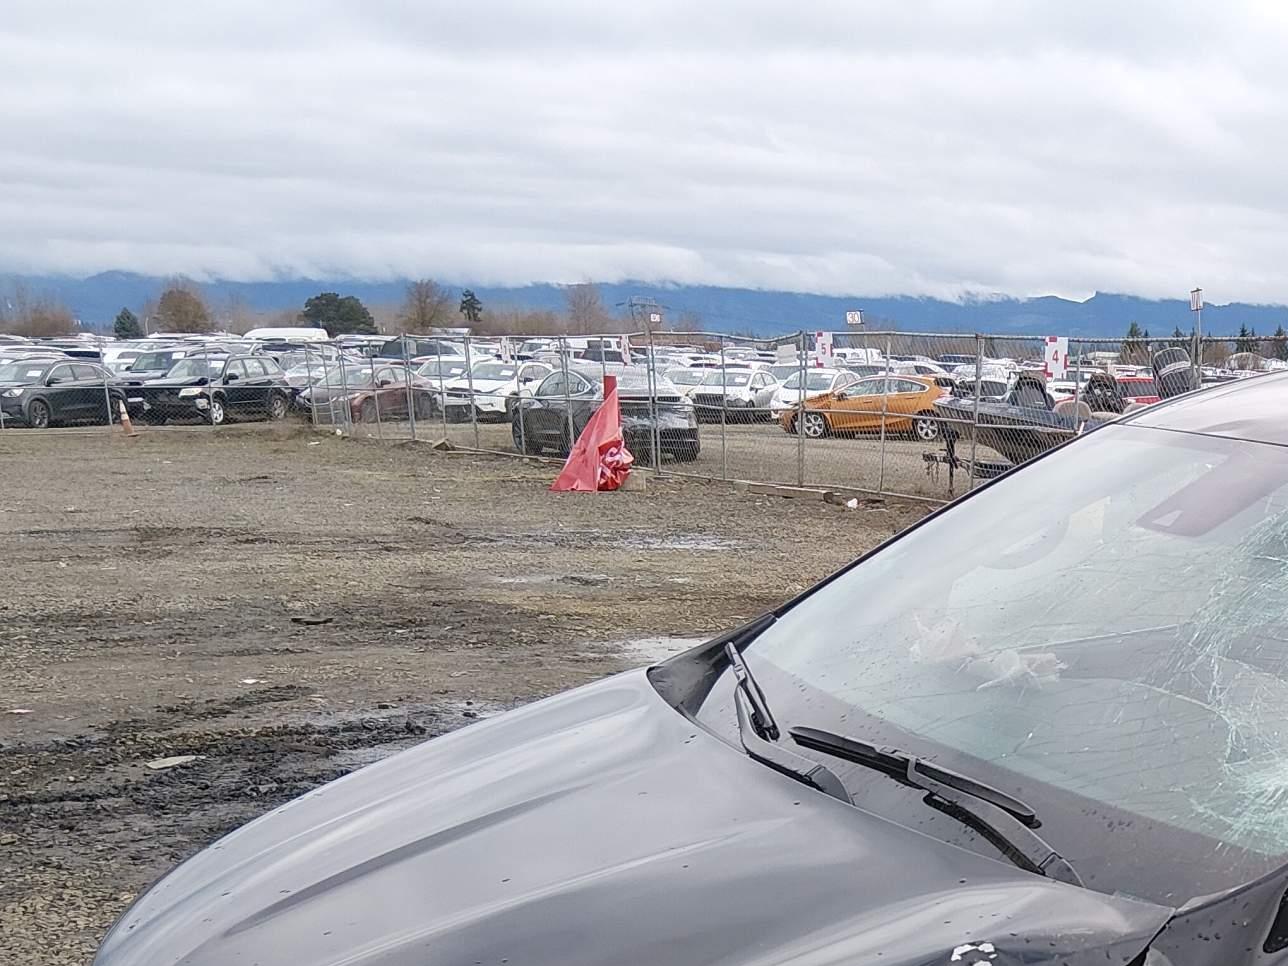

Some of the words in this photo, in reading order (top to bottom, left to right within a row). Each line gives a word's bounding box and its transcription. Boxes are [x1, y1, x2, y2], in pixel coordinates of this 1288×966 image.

[848, 312, 860, 323] 30
[820, 343, 827, 355] 5
[1051, 350, 1060, 364] 4
